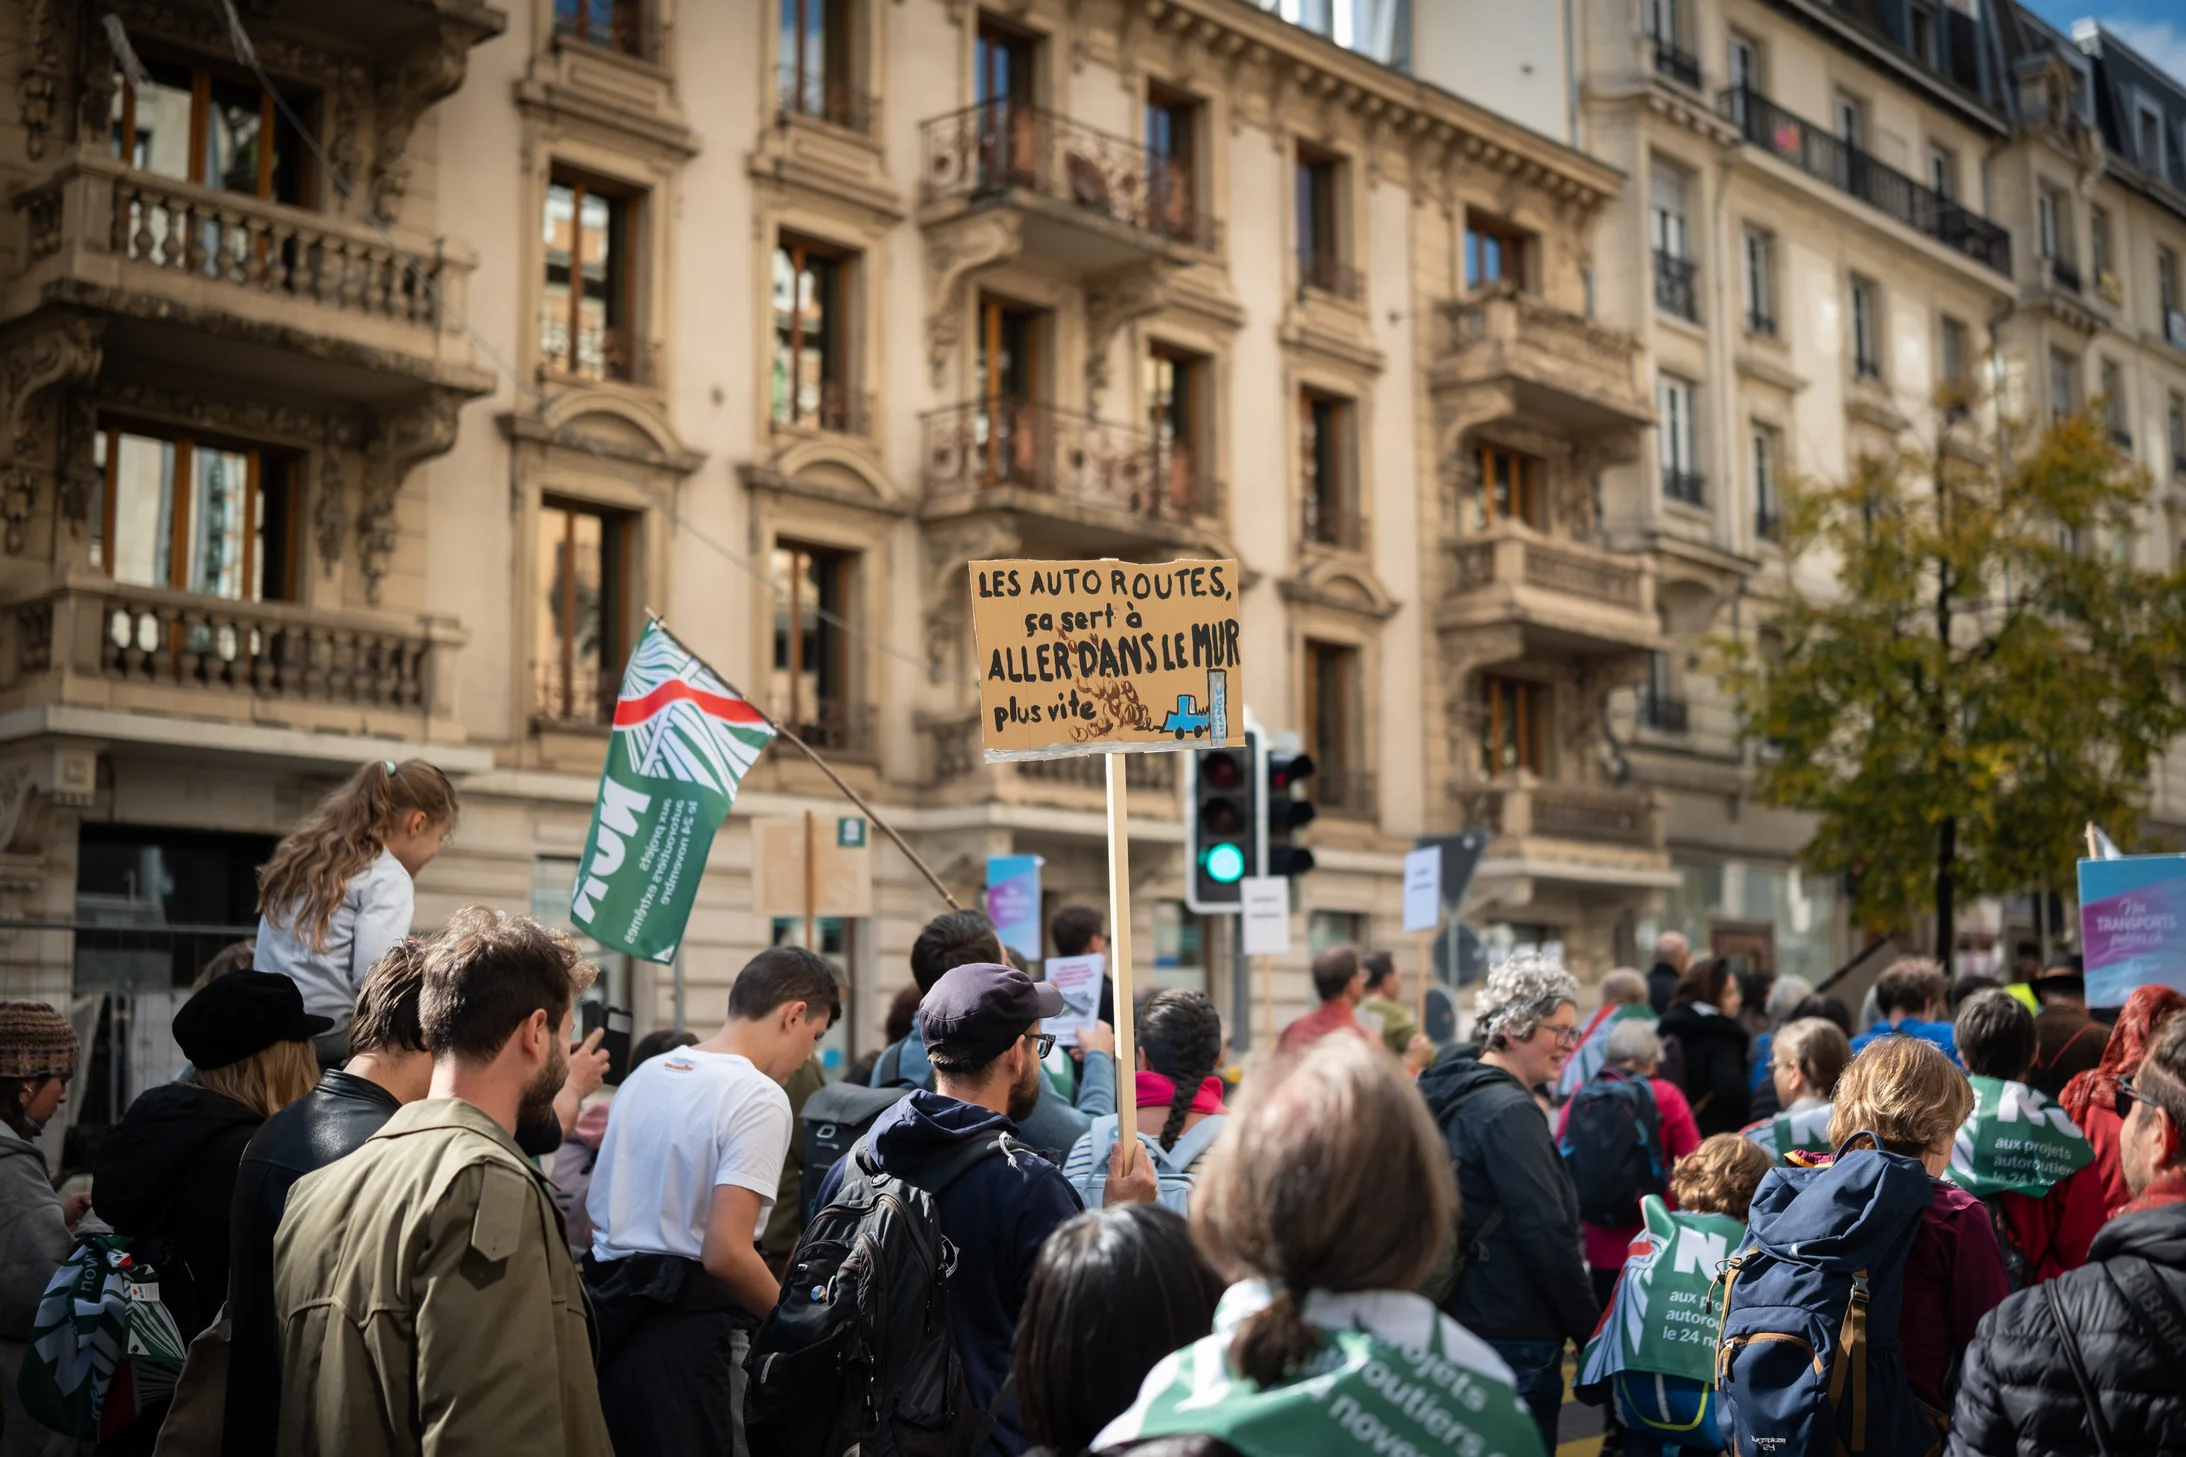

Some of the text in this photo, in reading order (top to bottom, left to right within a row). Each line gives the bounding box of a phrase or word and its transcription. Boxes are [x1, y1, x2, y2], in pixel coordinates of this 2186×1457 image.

[979, 570, 1021, 598] LES
[1024, 601, 1142, 637] ça sert à
[987, 618, 1240, 683] ALLER DANS LE MUR
[993, 689, 1097, 733] plus vite
[1994, 1137, 2072, 1160] aux projets
[1669, 1290, 1698, 1304] aux
[1662, 1325, 1677, 1341] le
[1679, 1328, 1700, 1344] 24
